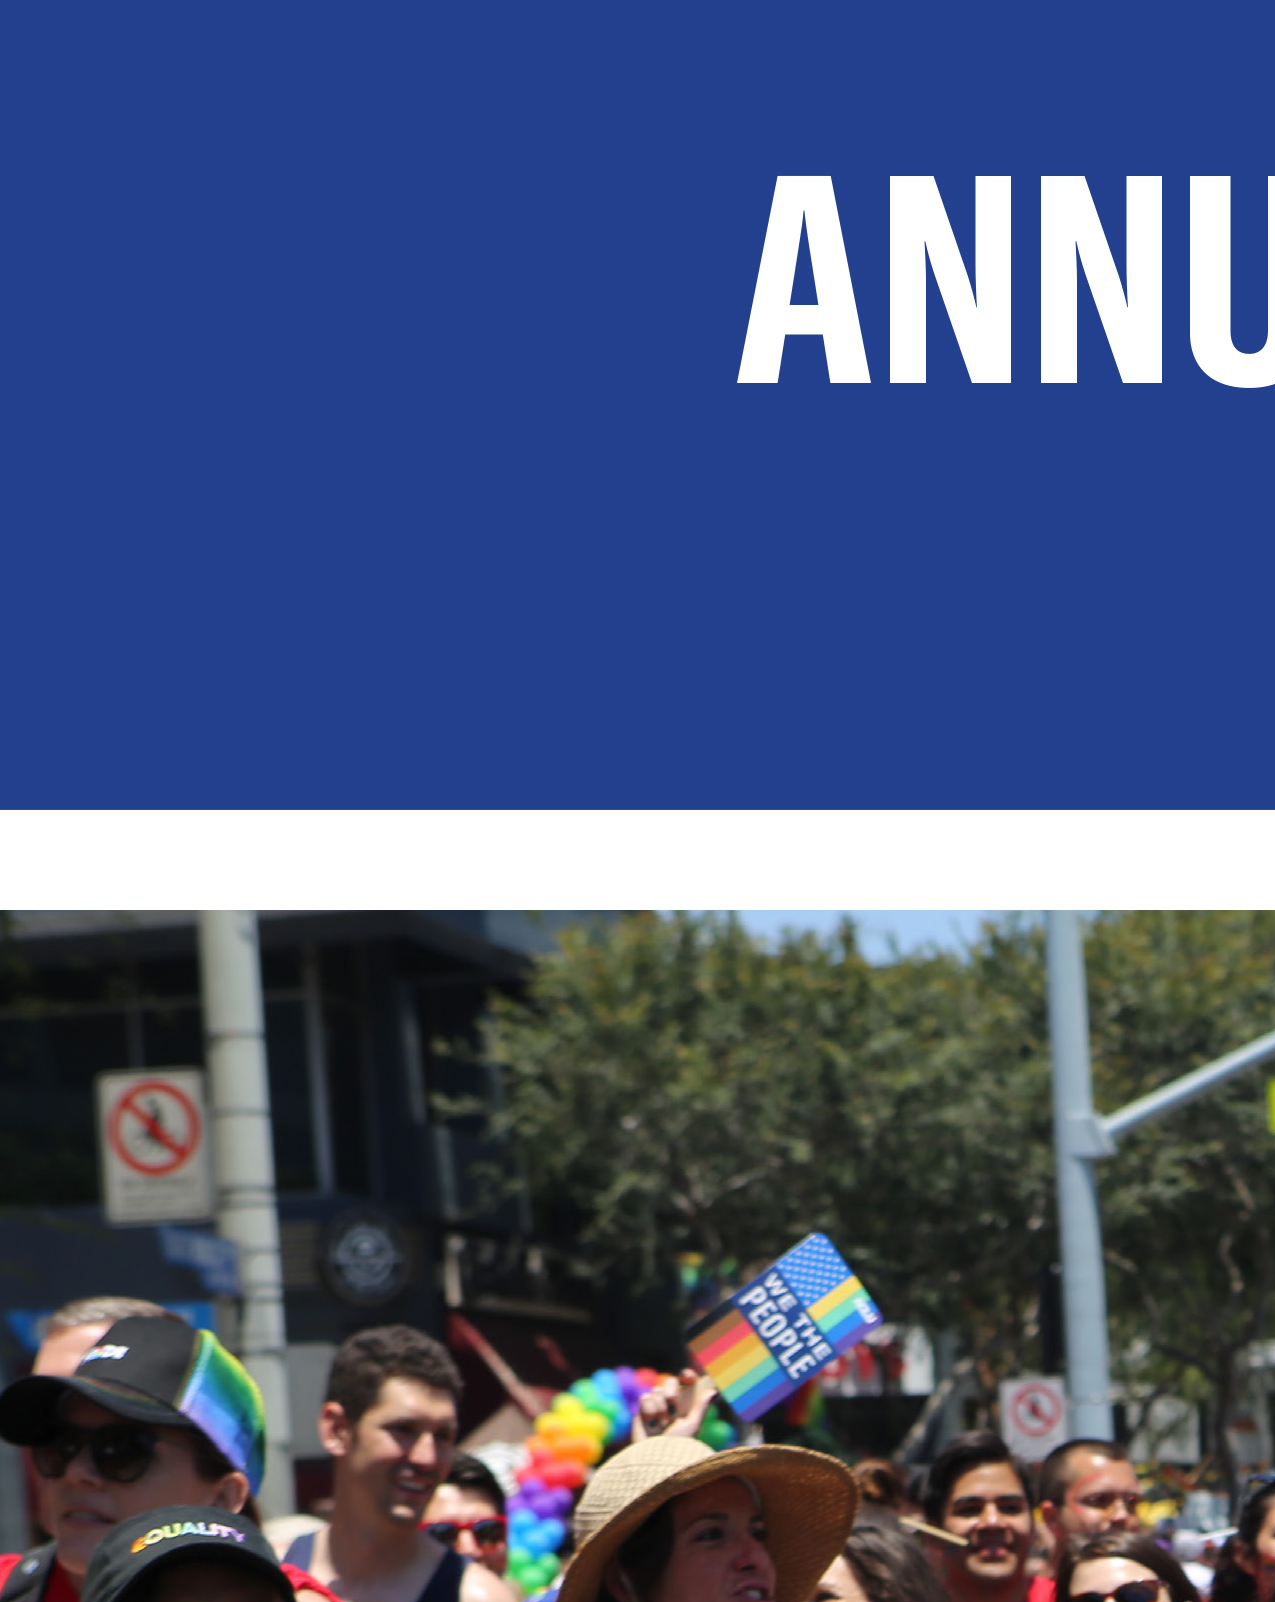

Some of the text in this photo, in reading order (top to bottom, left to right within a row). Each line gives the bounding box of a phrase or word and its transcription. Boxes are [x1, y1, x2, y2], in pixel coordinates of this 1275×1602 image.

[737, 1286, 817, 1380] PEOPLE
[764, 1272, 834, 1361] WE THE
